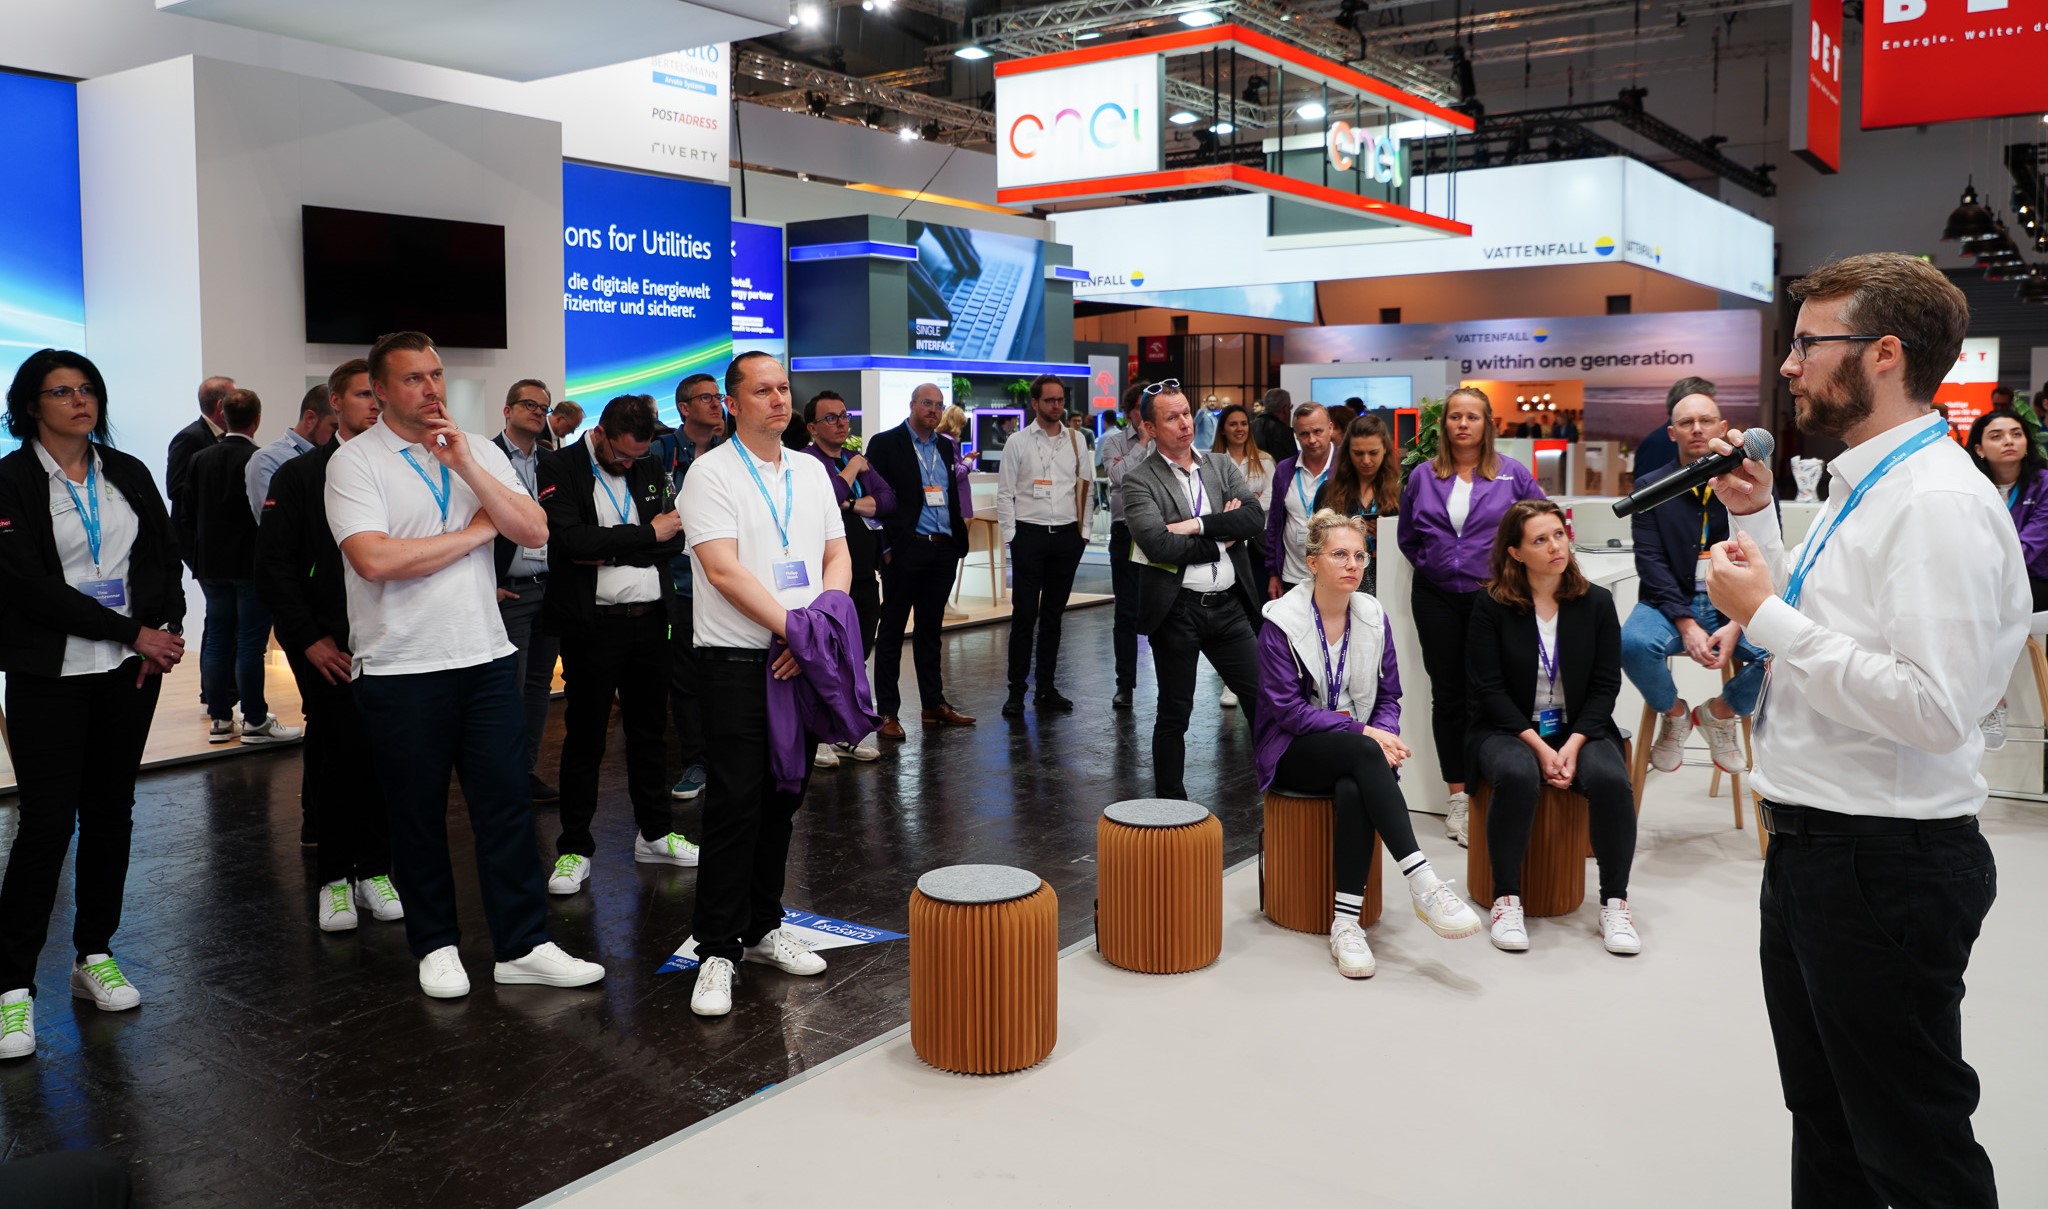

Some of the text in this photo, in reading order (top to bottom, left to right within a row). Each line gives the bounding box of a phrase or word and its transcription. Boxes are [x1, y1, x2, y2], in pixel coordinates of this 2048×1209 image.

[1964, 25, 2023, 40] Weiter
[1811, 20, 1840, 82] BET
[651, 107, 718, 130] POSTADRESS
[1009, 83, 1142, 160] enel
[1326, 114, 1403, 188] enel
[608, 224, 637, 252] for
[642, 229, 712, 260] Utilities
[1483, 241, 1588, 260] VATTENFALL
[568, 272, 711, 301] die digitale Energiewelt
[563, 293, 696, 318] fizienter und sicherer.
[915, 325, 941, 337] SINGLE
[1455, 333, 1529, 344] VATTENFALL
[915, 340, 956, 352] INTERFACE
[1476, 353, 1534, 370] within
[1539, 354, 1576, 369] one
[1580, 350, 1694, 371] generation
[820, 923, 875, 940] CURSOR
